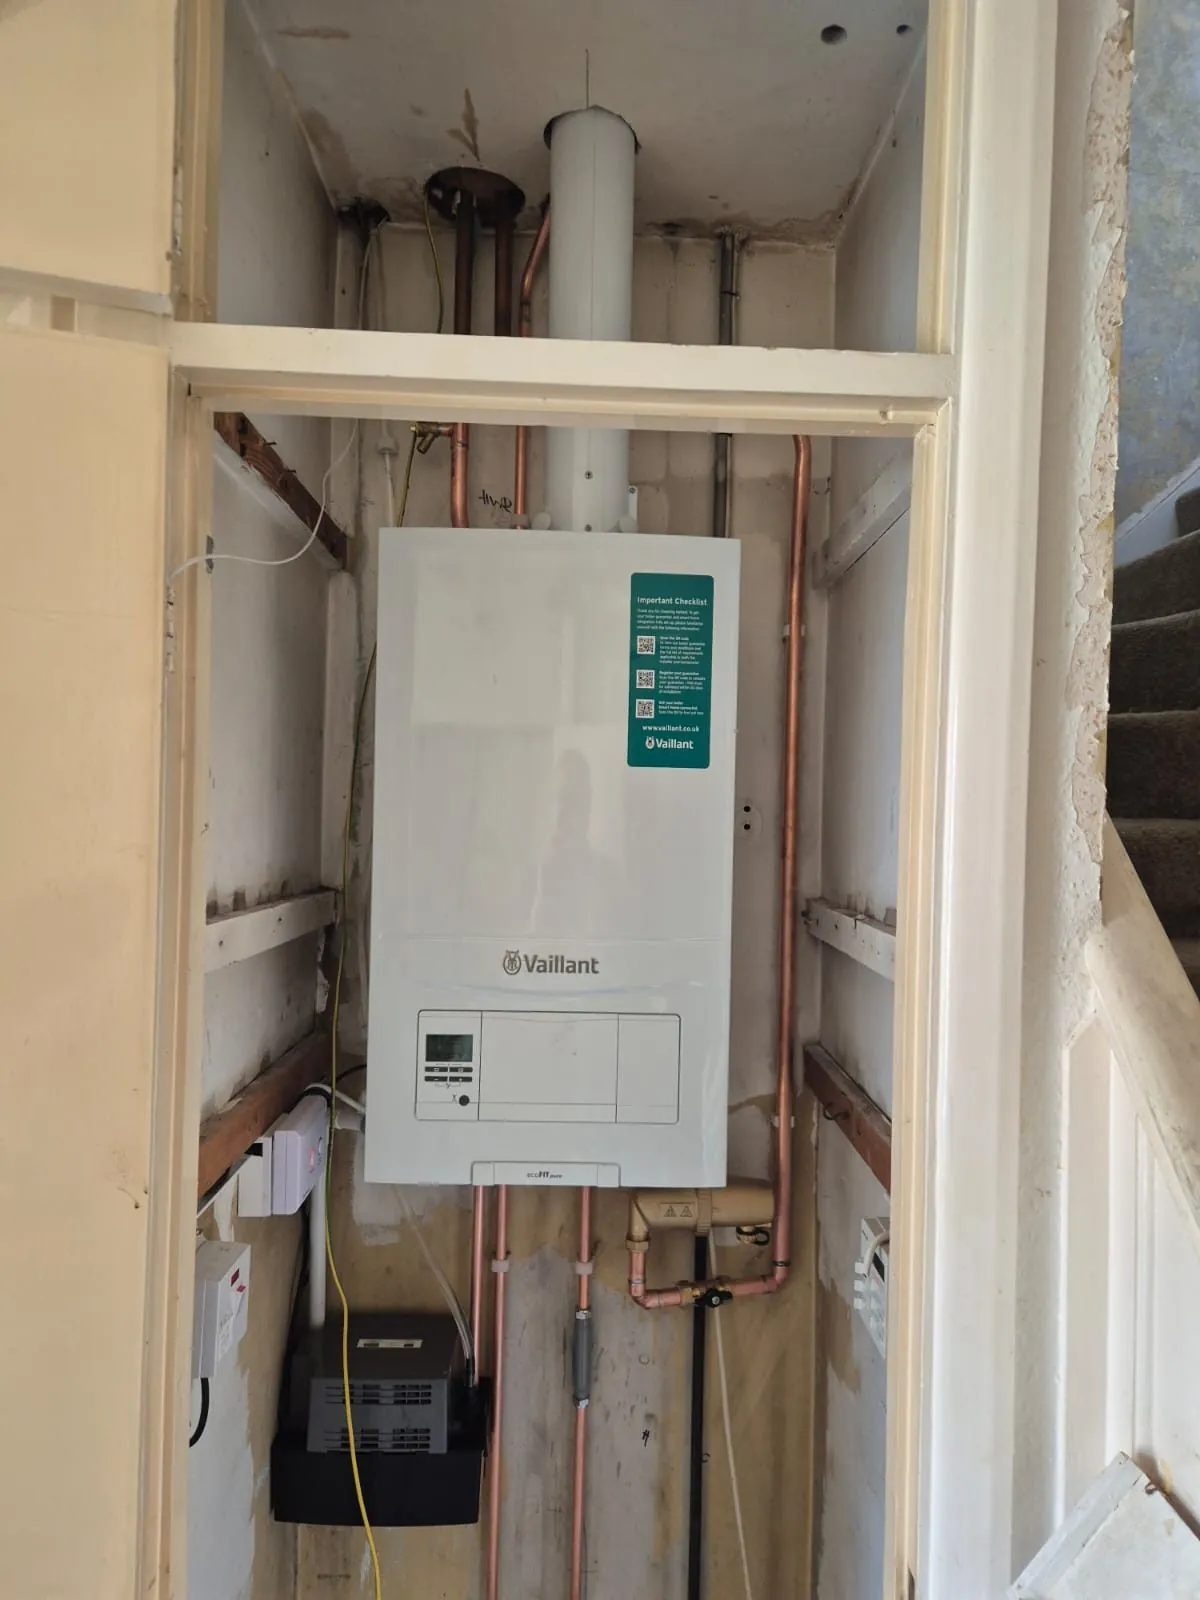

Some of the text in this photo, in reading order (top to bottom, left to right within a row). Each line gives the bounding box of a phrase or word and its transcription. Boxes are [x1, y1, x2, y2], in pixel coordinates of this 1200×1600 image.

[637, 596, 708, 606] Important Checklist
[642, 724, 700, 732] www.vaillant.co.uk
[655, 738, 694, 749] Vaillant
[523, 954, 600, 974] Vaillant
